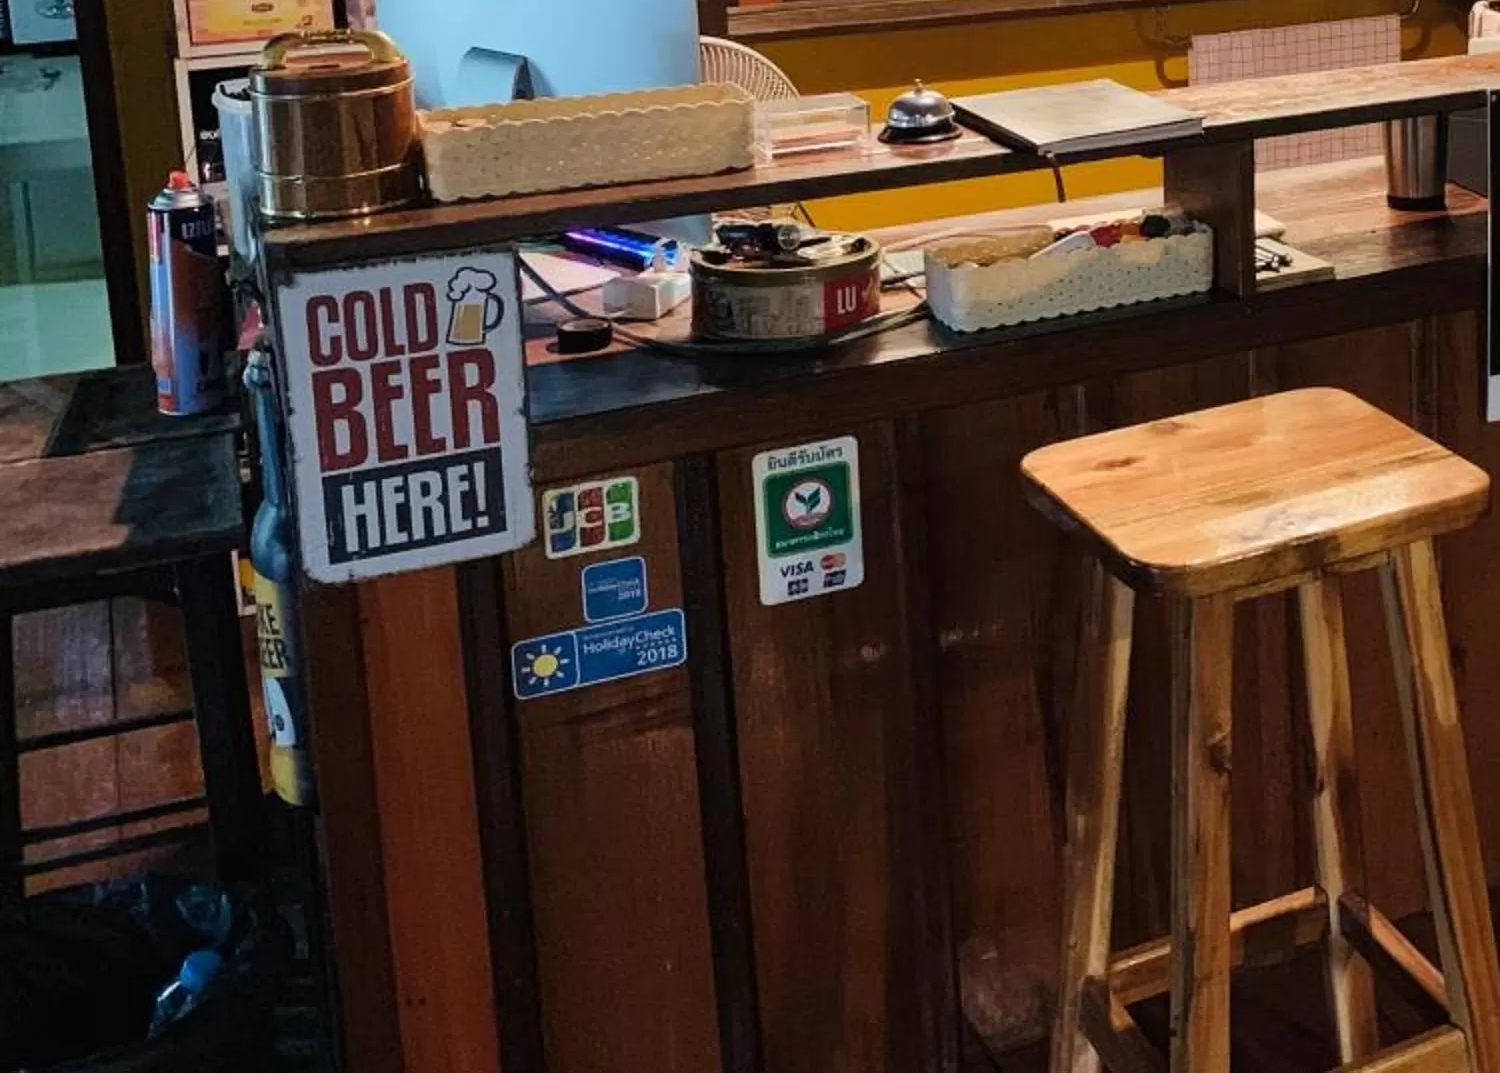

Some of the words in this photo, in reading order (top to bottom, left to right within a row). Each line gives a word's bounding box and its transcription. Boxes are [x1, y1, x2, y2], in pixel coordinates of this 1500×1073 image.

[837, 285, 858, 315] LU
[305, 282, 439, 366] COLD
[312, 348, 501, 474] BEER
[340, 460, 490, 554] HERE!
[779, 560, 815, 578] VISA
[583, 624, 676, 656] HolidayCheck
[636, 644, 679, 667] 2018
